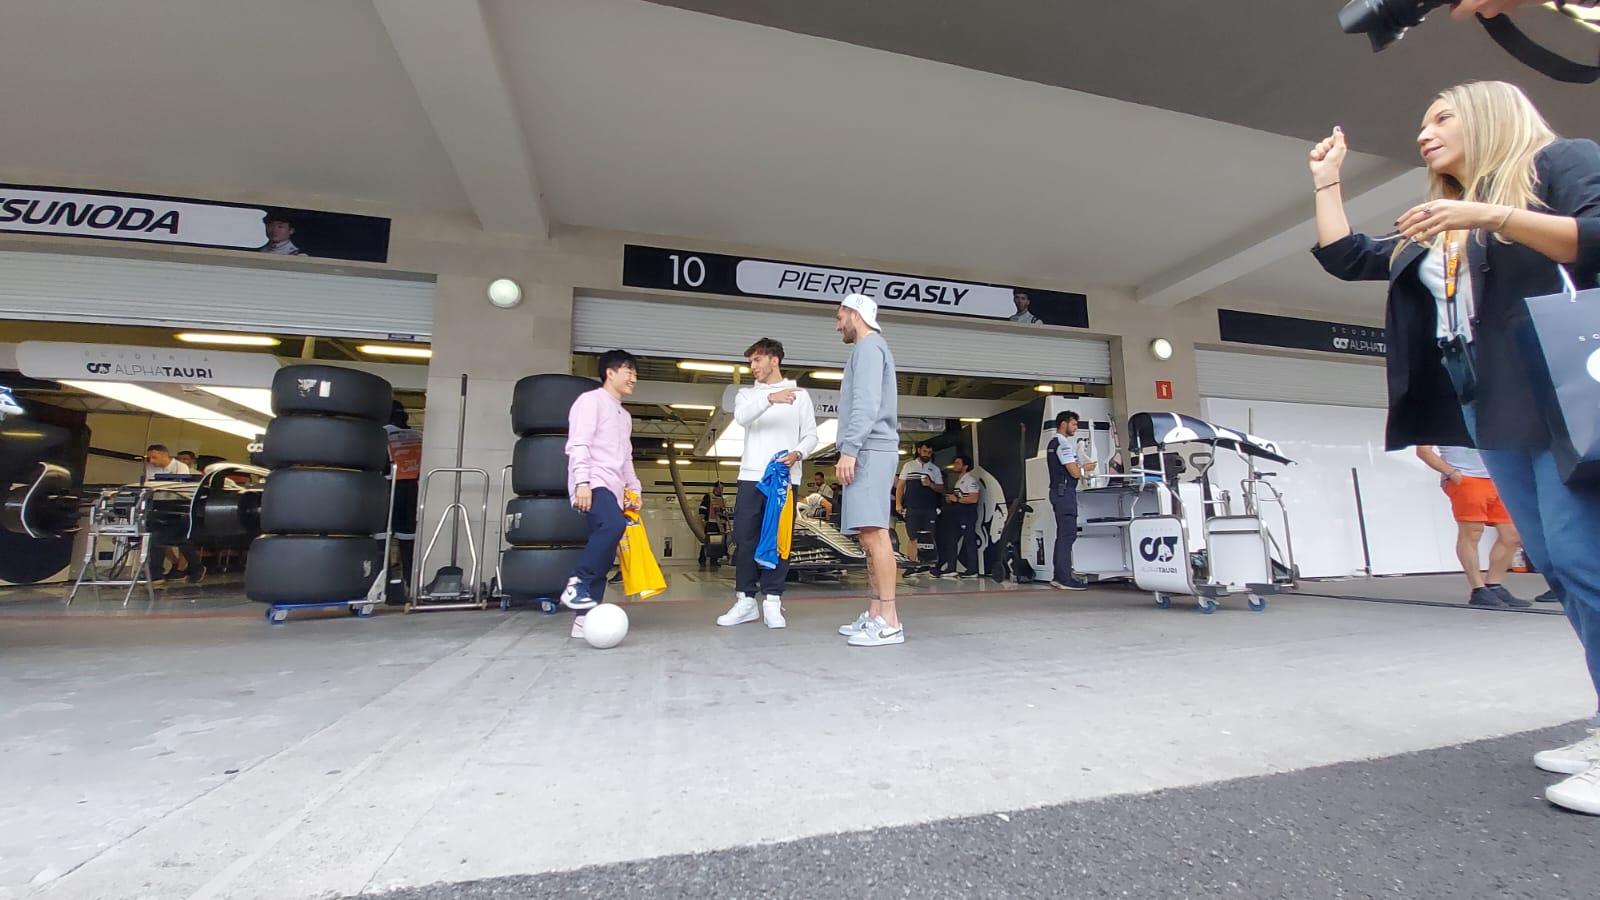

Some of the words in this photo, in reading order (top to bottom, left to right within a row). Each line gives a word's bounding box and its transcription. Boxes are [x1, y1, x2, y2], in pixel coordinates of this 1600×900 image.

[669, 254, 706, 287] 10
[778, 269, 880, 298] PIERRE
[883, 280, 970, 306] GASLY
[115, 363, 214, 379] ALPHATAURI
